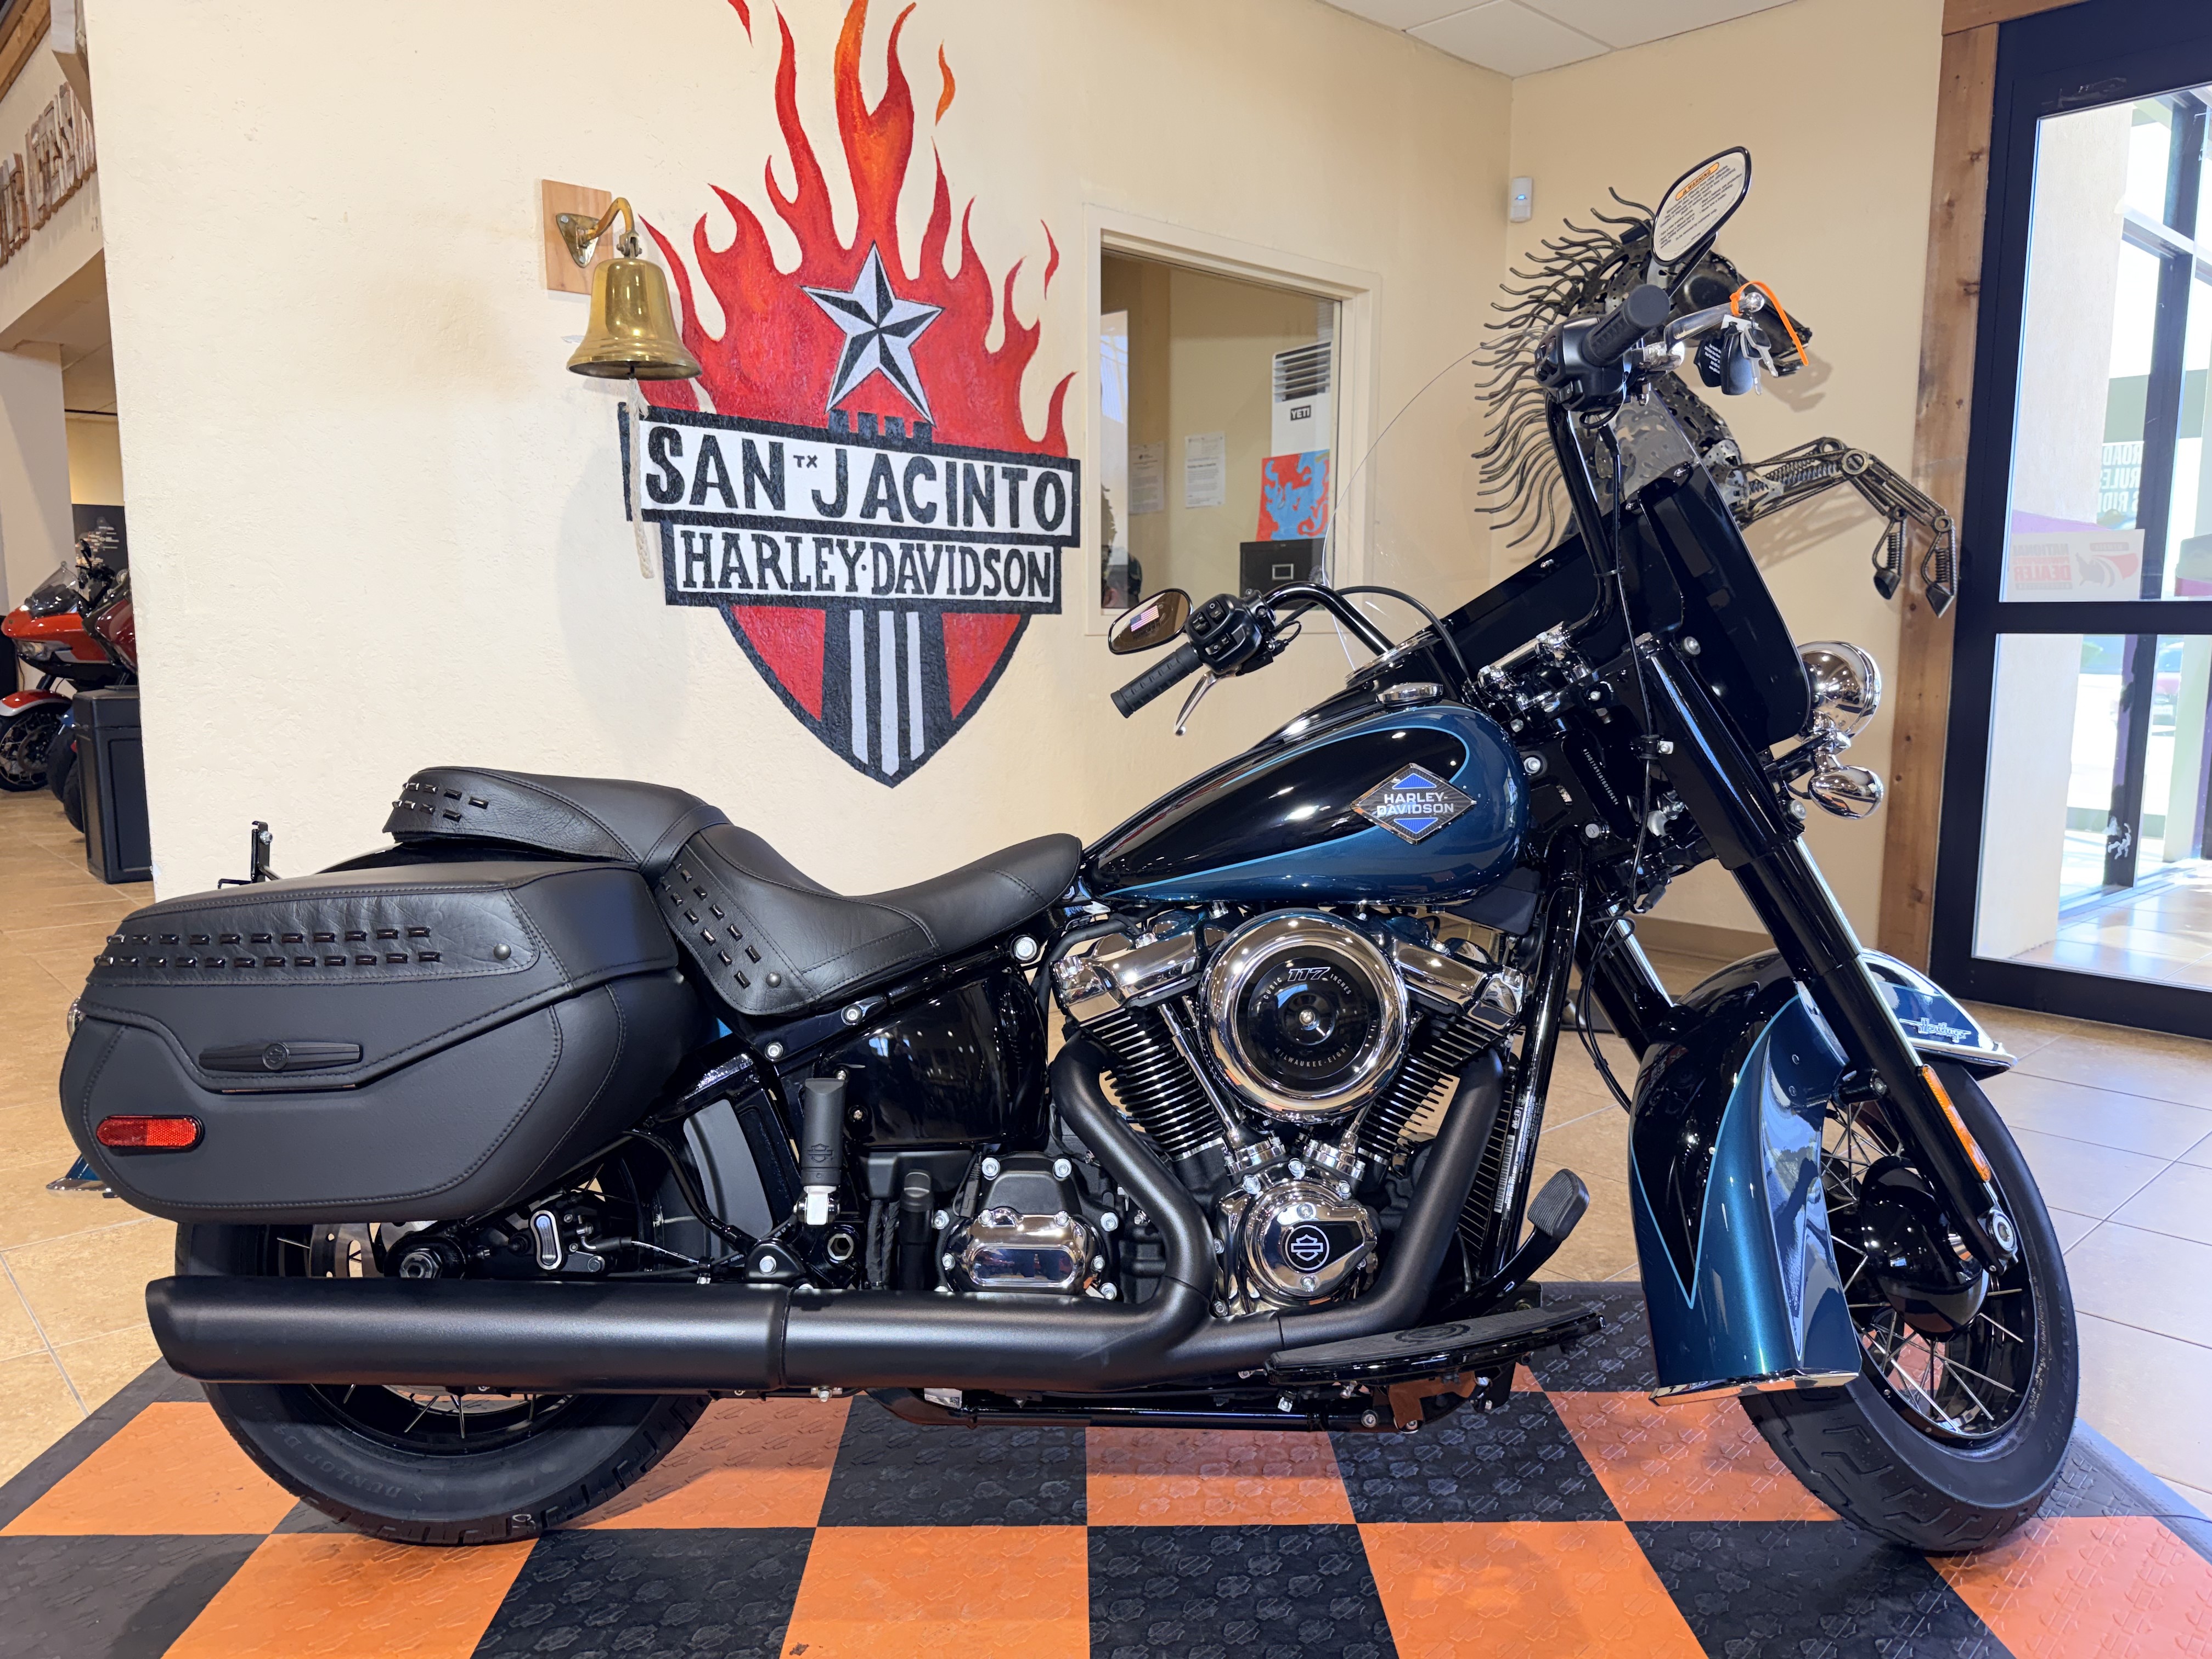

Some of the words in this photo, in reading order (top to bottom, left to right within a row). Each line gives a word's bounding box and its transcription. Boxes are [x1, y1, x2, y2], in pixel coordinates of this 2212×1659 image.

[1688, 170, 1710, 189] WARNING
[1291, 408, 1310, 419] YETI
[646, 426, 786, 510] SAN
[793, 454, 817, 469] TX
[812, 448, 1066, 532] JACINTO
[1384, 792, 1448, 804] HARLEY-
[1376, 803, 1454, 816] DAVIDSON
[1263, 977, 1282, 1000] CUBIC
[1288, 967, 1331, 982] 117
[1330, 974, 1352, 995] INCHES
[303, 1454, 403, 1498] DUNLOP
